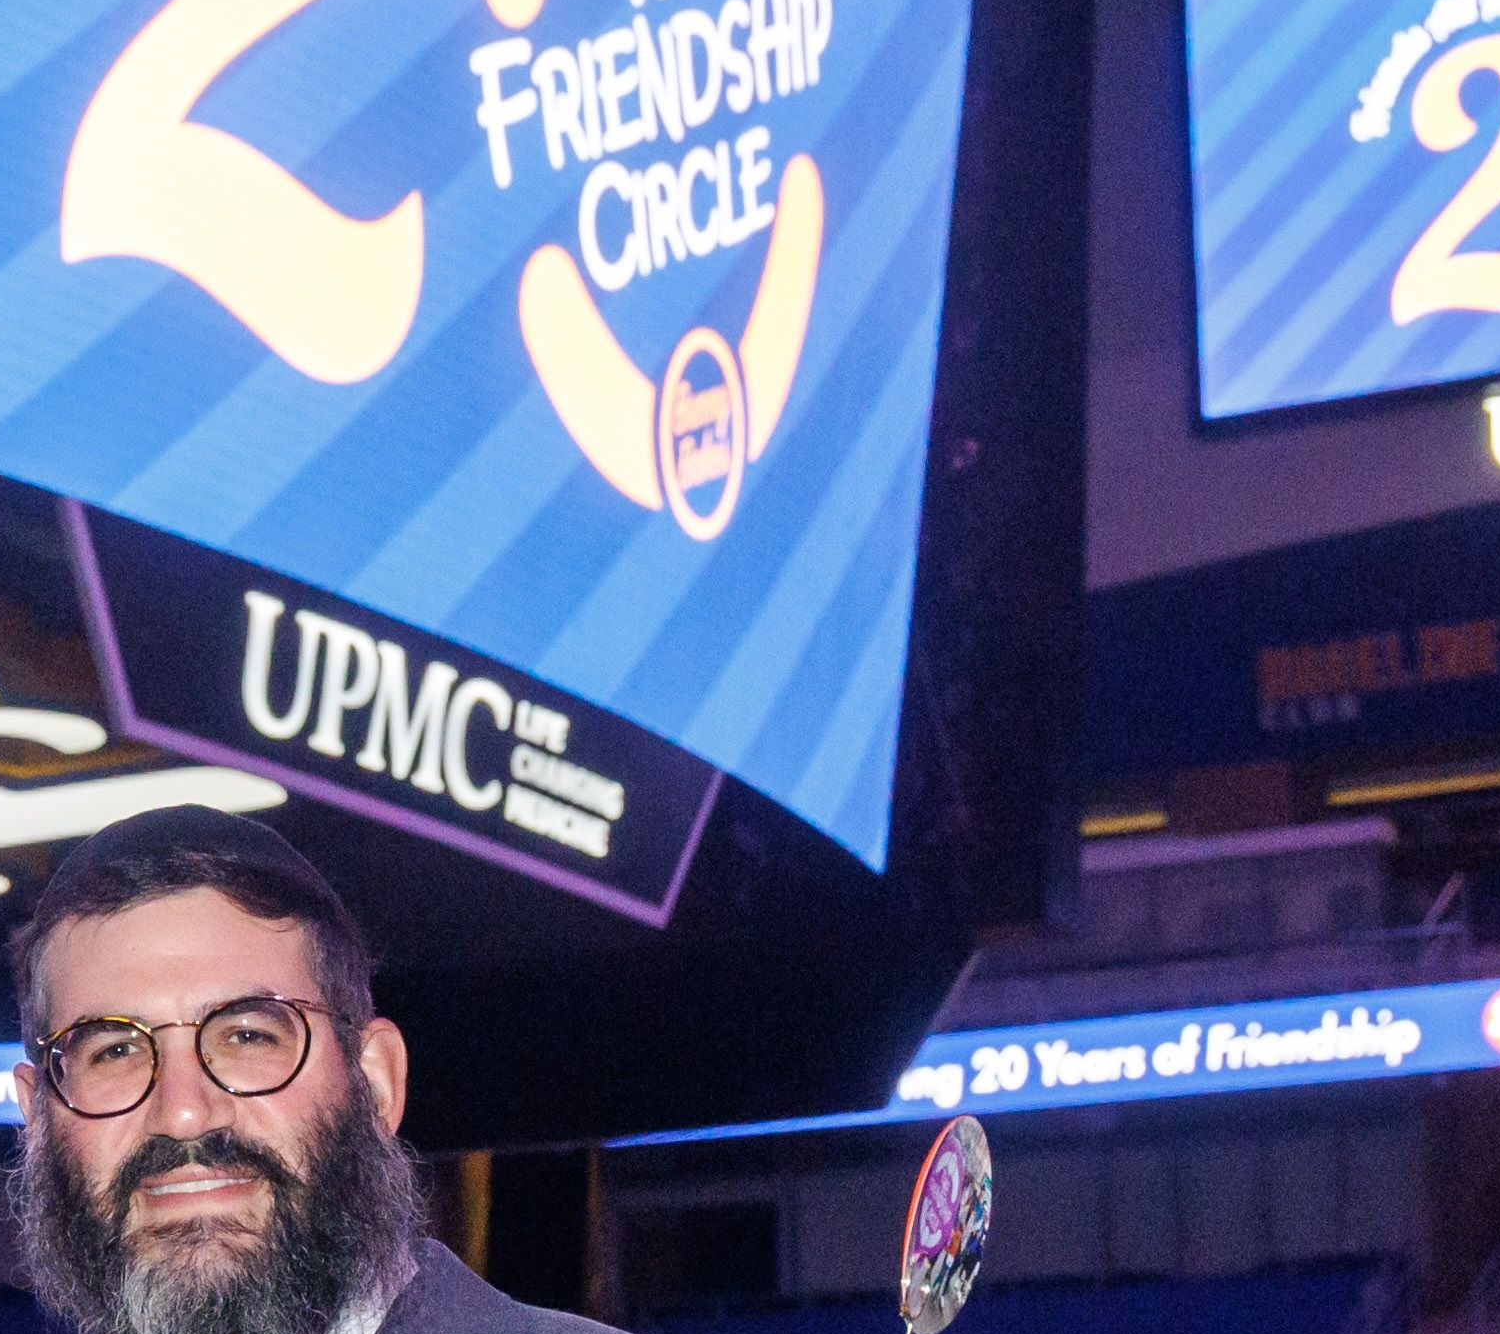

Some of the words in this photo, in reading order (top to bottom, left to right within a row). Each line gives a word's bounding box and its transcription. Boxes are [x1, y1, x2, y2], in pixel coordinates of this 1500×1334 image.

[577, 126, 775, 292] CIRCLE
[241, 590, 511, 813] UPMC
[969, 1044, 1029, 1094] 20
[1033, 1041, 1146, 1088] Years
[1152, 1024, 1204, 1077] of
[1206, 1007, 1421, 1072] Friendship
